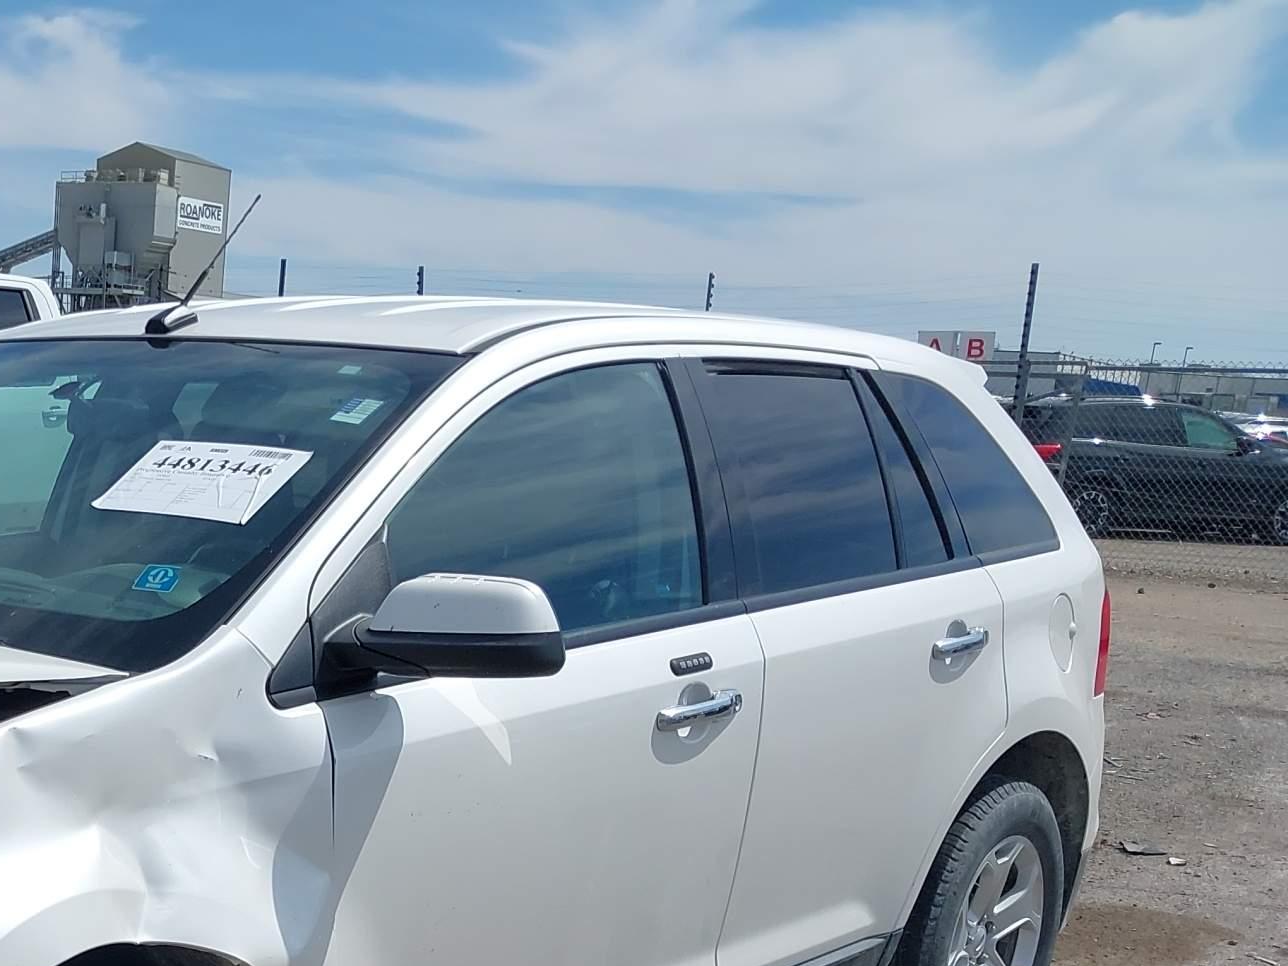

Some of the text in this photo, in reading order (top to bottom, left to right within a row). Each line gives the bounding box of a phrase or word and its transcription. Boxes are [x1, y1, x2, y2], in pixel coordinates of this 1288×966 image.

[180, 203, 222, 221] ROANOKE
[179, 220, 221, 232] CONCRETE PRODUCTS
[967, 339, 985, 358] B
[153, 456, 274, 476] 44813446
